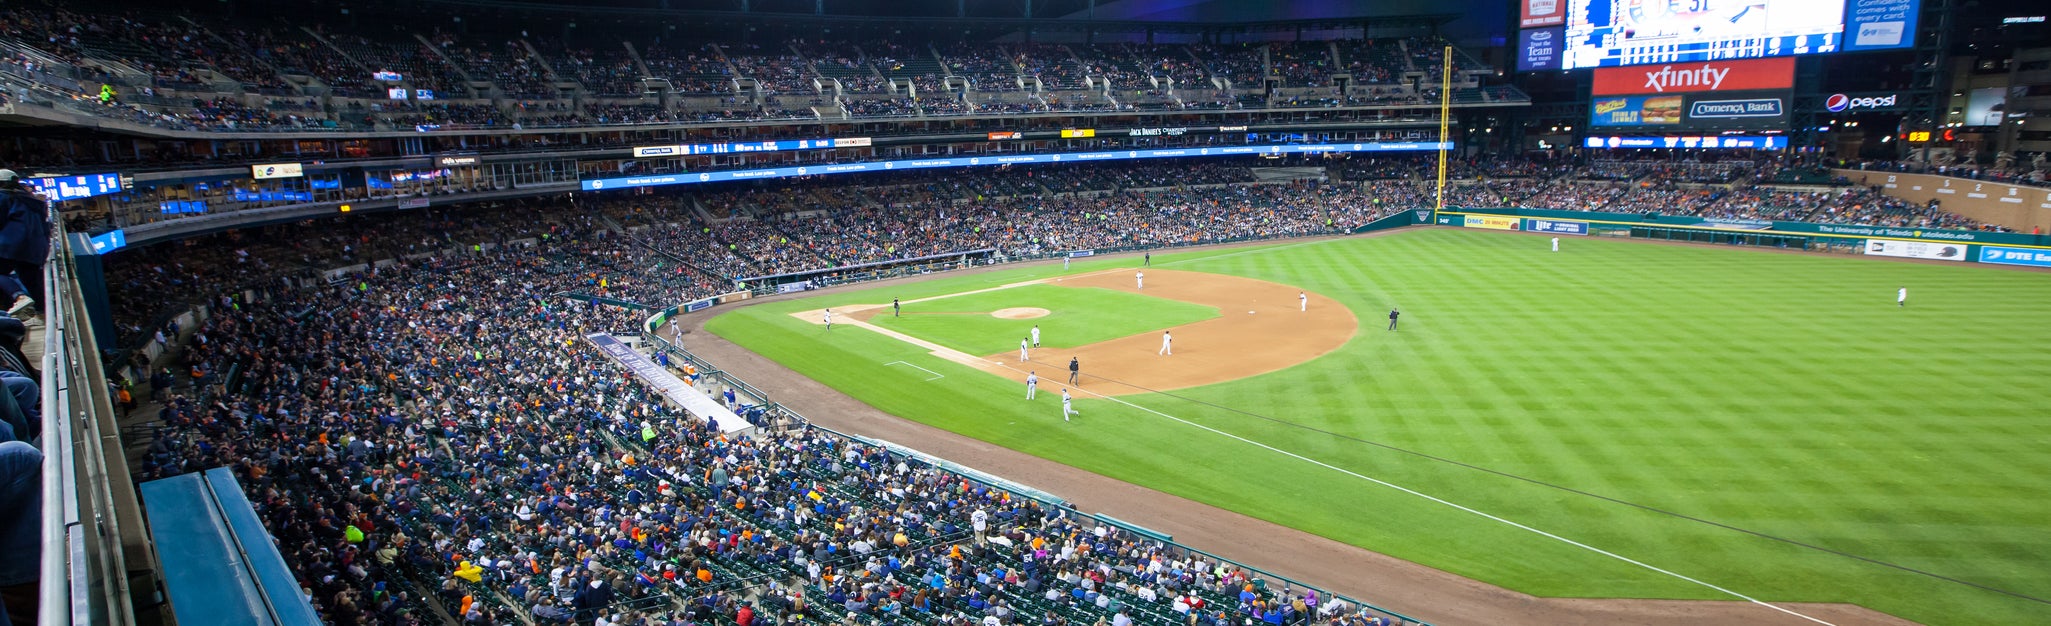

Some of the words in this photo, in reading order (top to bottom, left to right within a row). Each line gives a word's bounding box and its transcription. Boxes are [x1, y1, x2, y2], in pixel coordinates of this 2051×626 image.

[1527, 46, 1552, 56] Team
[1644, 64, 1730, 92] xfinity
[1849, 94, 1896, 109] pepsi
[1747, 102, 1775, 112] Bank
[1536, 220, 1552, 230] Lite
[1835, 226, 1873, 236] University
[1886, 228, 1912, 236] Toledo
[1922, 230, 1974, 240] utoledo.edu
[2005, 252, 2032, 260] DTE
